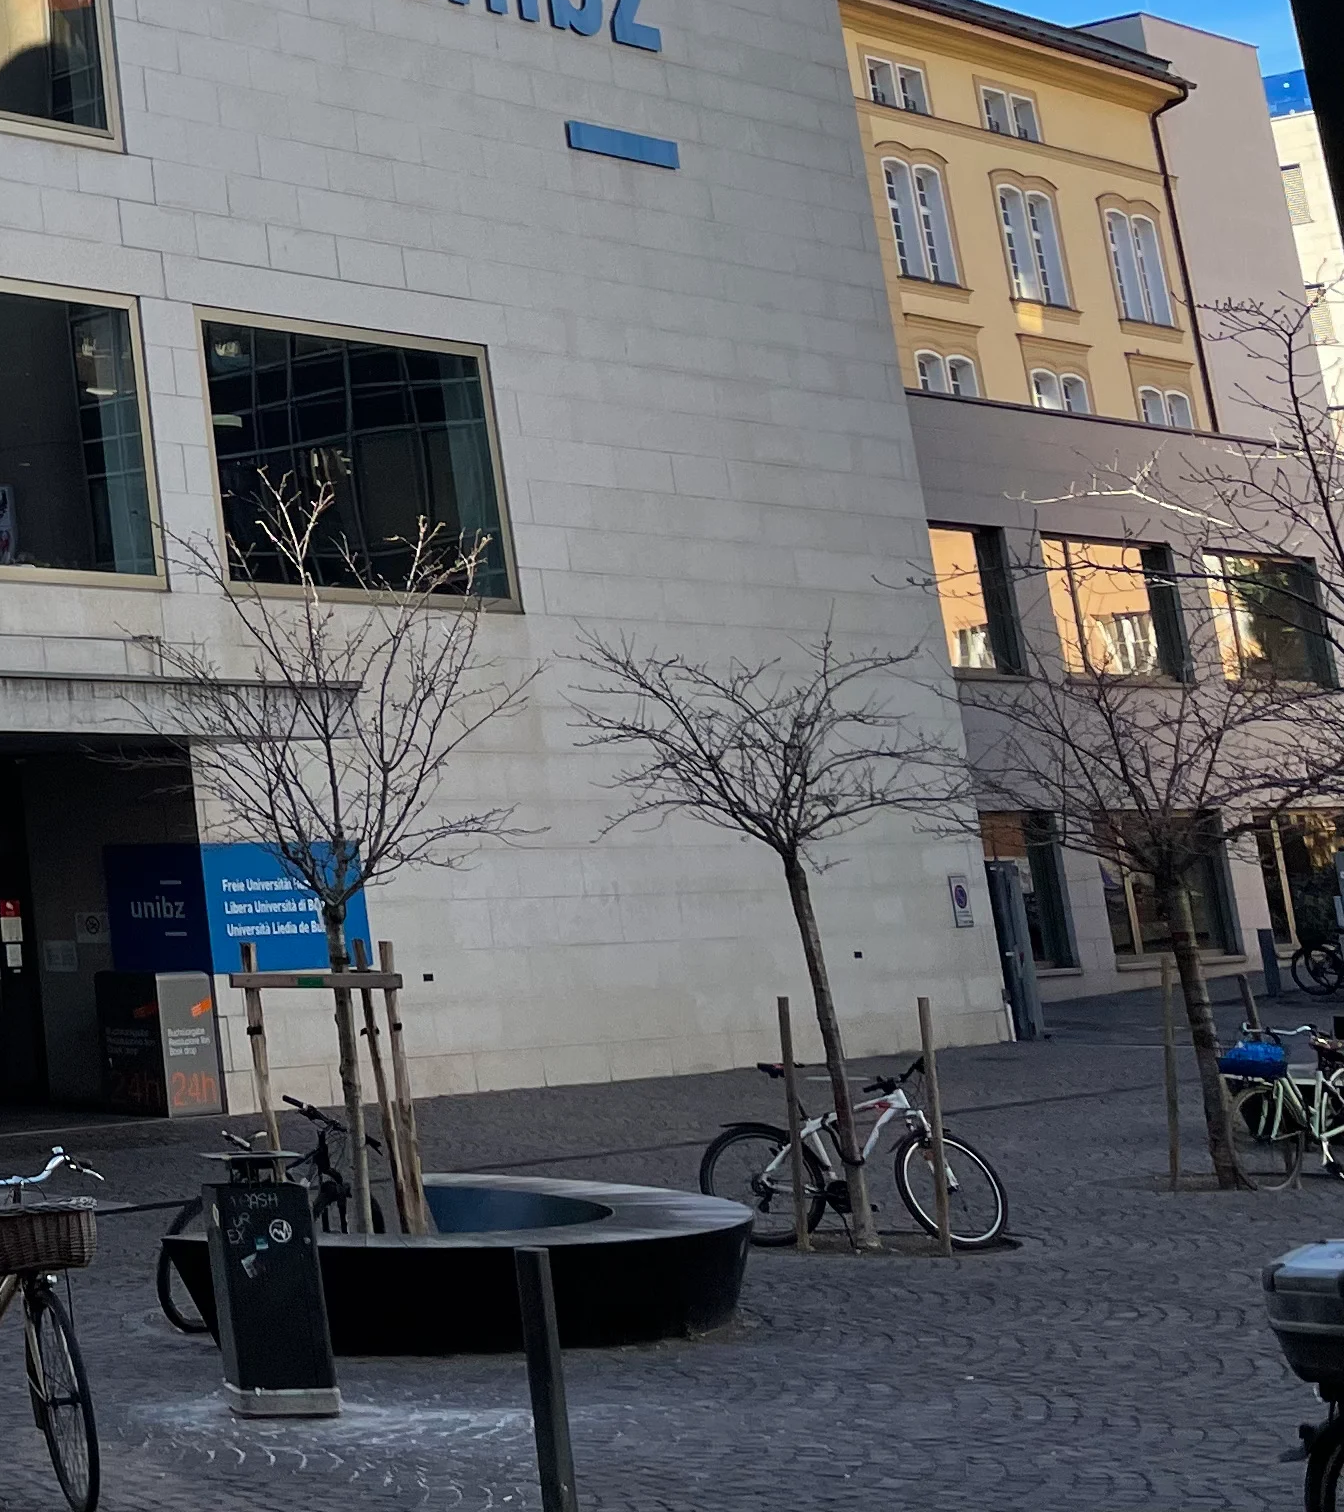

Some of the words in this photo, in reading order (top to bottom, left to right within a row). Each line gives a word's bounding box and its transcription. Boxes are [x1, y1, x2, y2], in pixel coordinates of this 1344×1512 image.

[222, 878, 245, 892] Freie
[130, 896, 186, 919] unibz
[224, 900, 253, 915] Libera
[254, 898, 297, 913] Università
[298, 899, 307, 912] di
[226, 920, 271, 937] Università
[298, 920, 310, 934] de
[172, 1071, 217, 1106] 24h
